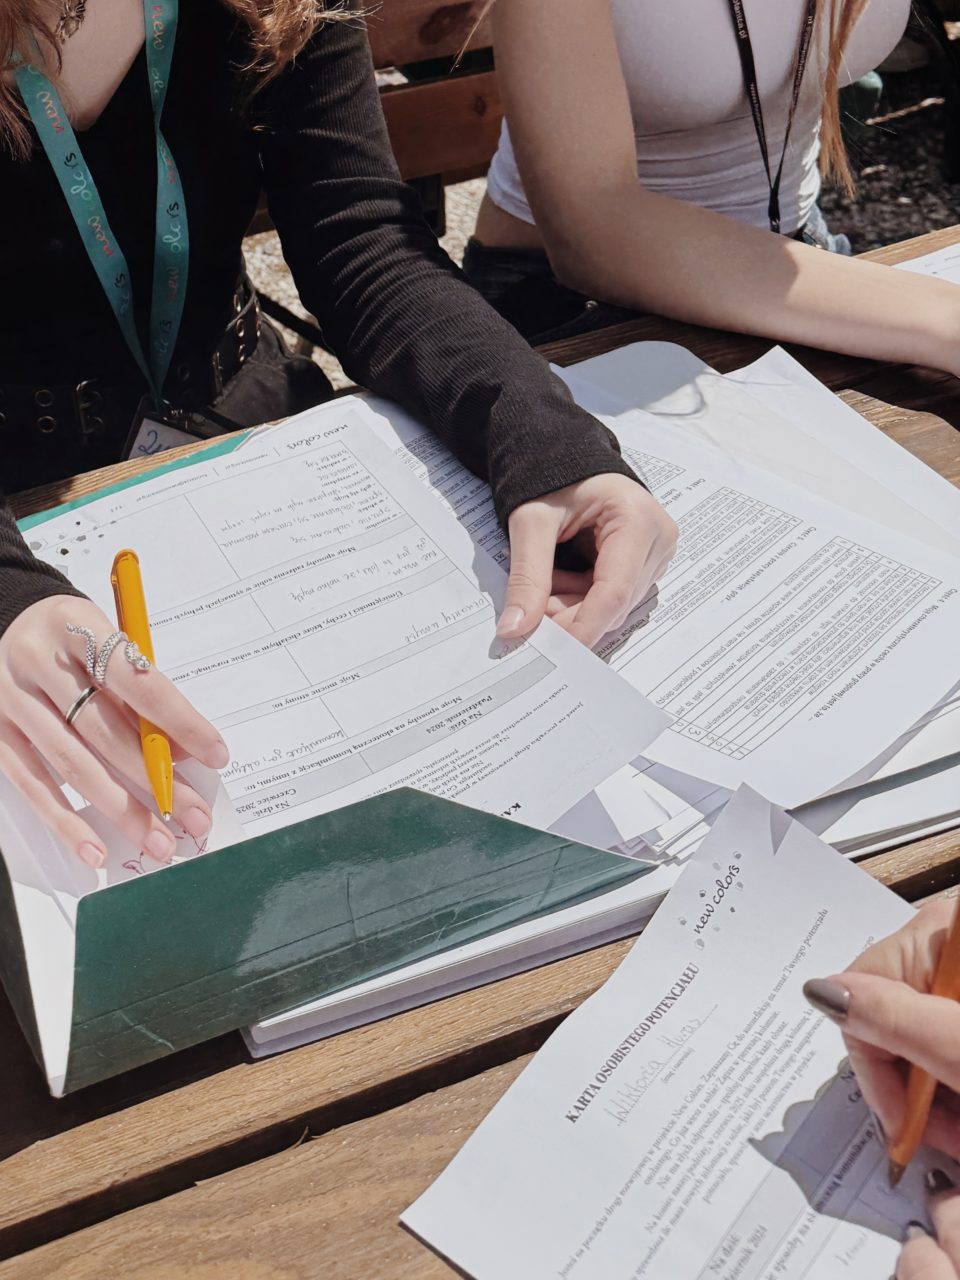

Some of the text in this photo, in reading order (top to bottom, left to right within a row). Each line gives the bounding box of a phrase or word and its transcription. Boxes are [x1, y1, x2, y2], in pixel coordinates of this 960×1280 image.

[286, 423, 349, 452] new colors
[425, 721, 446, 734] 2024
[235, 802, 256, 814] 2025
[692, 864, 740, 934] new colors
[565, 1083, 602, 1124] KARTA
[595, 1022, 652, 1084] OSOBISTEGO
[644, 962, 699, 1025] POTENCJAŁU
